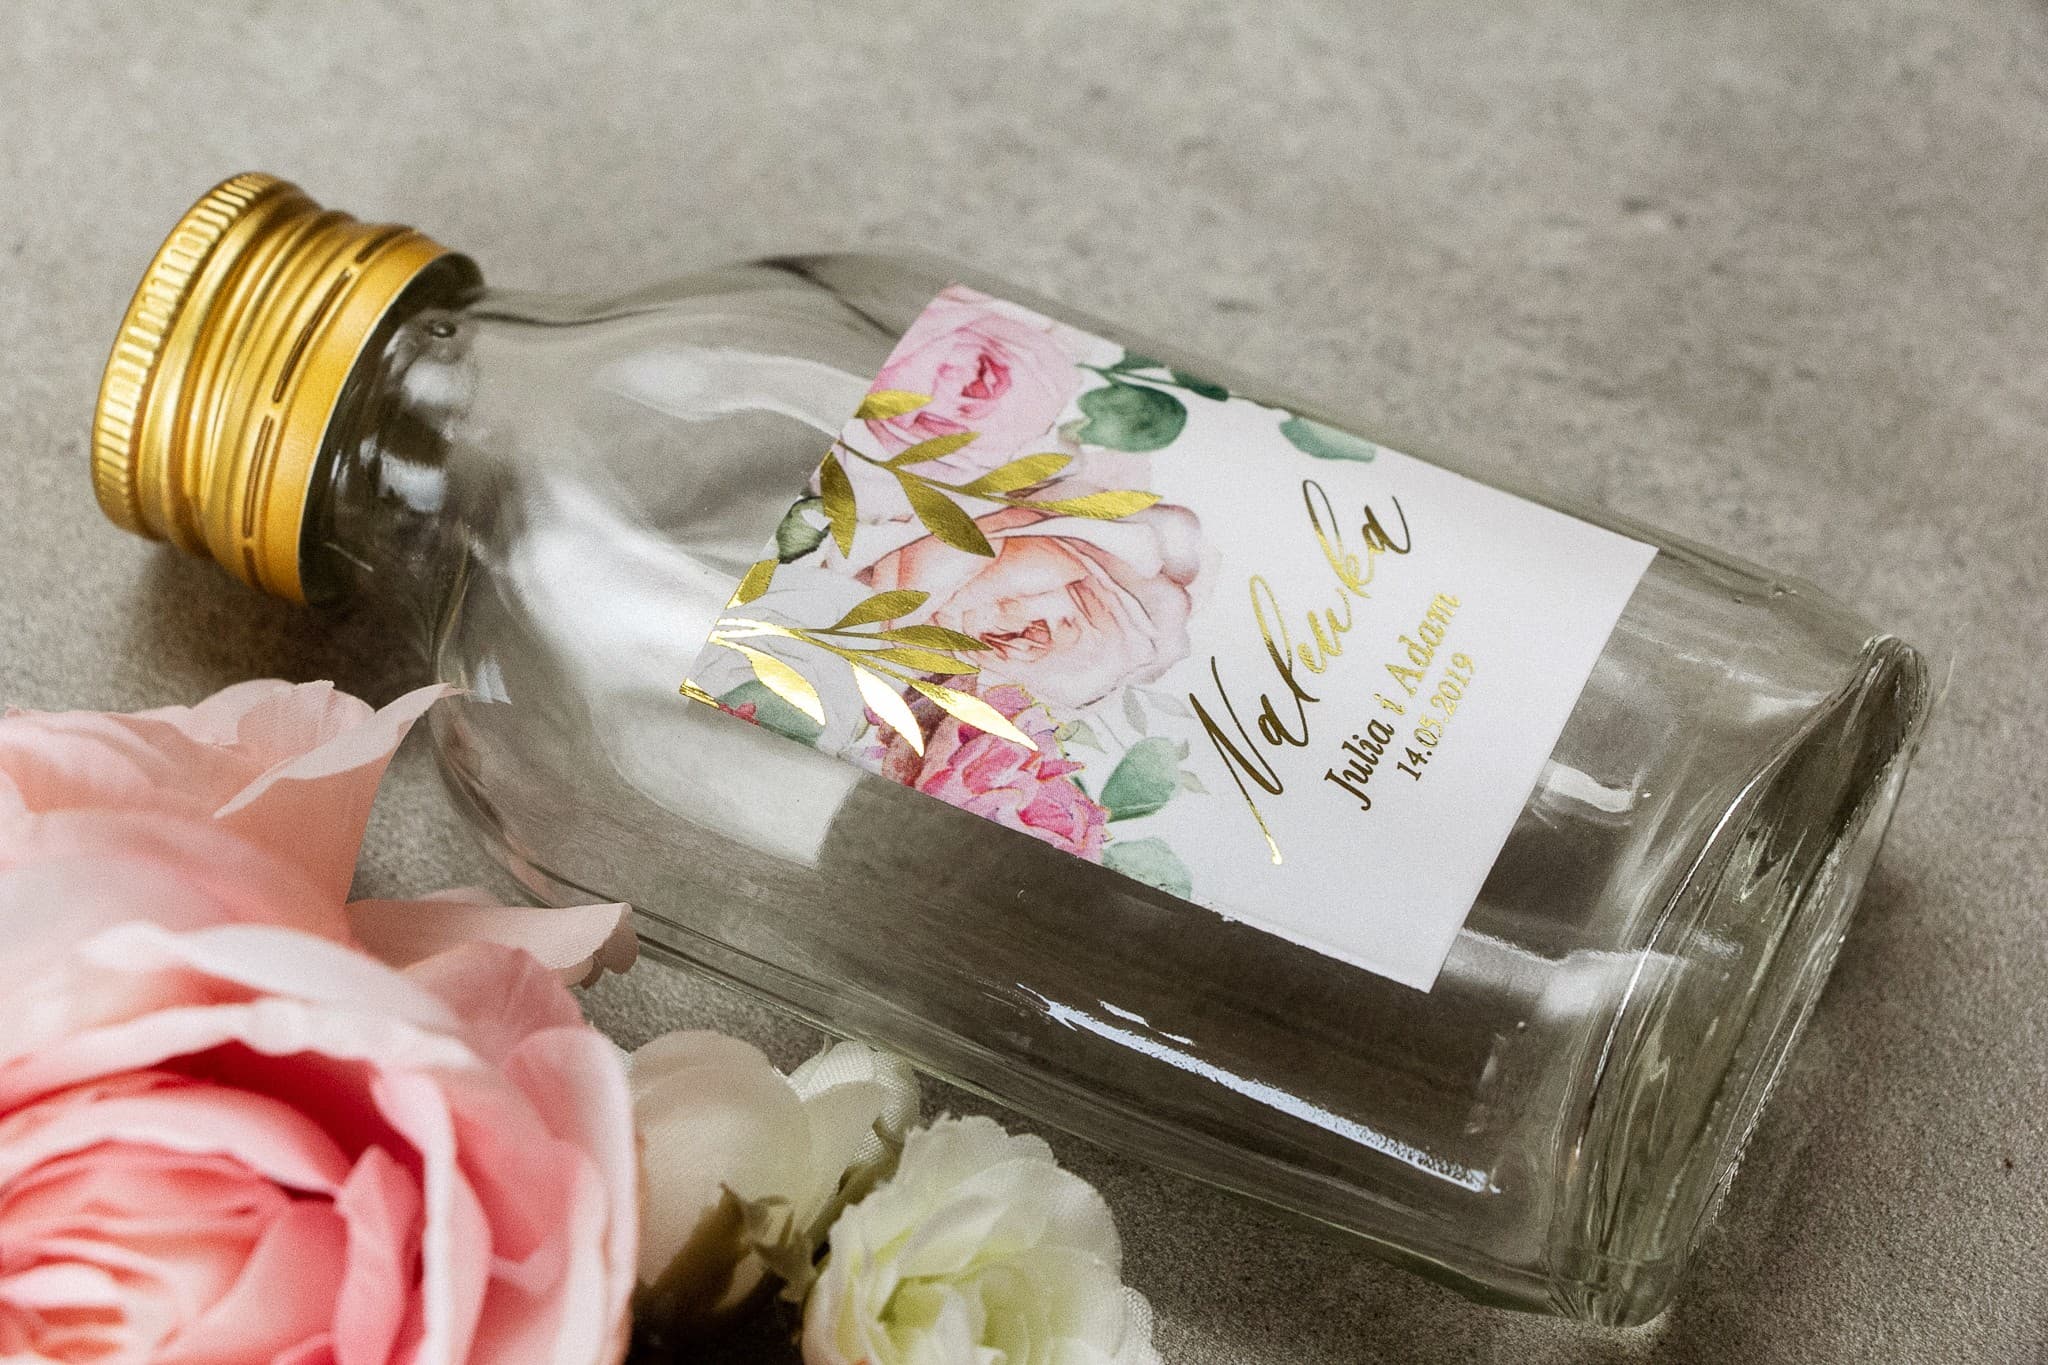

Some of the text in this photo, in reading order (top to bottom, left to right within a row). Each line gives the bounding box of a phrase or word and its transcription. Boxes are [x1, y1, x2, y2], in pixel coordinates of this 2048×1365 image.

[1188, 479, 1412, 866] Nalewka
[1323, 592, 1462, 811] Julia i Adam
[1396, 652, 1475, 782] 14.05.2019
